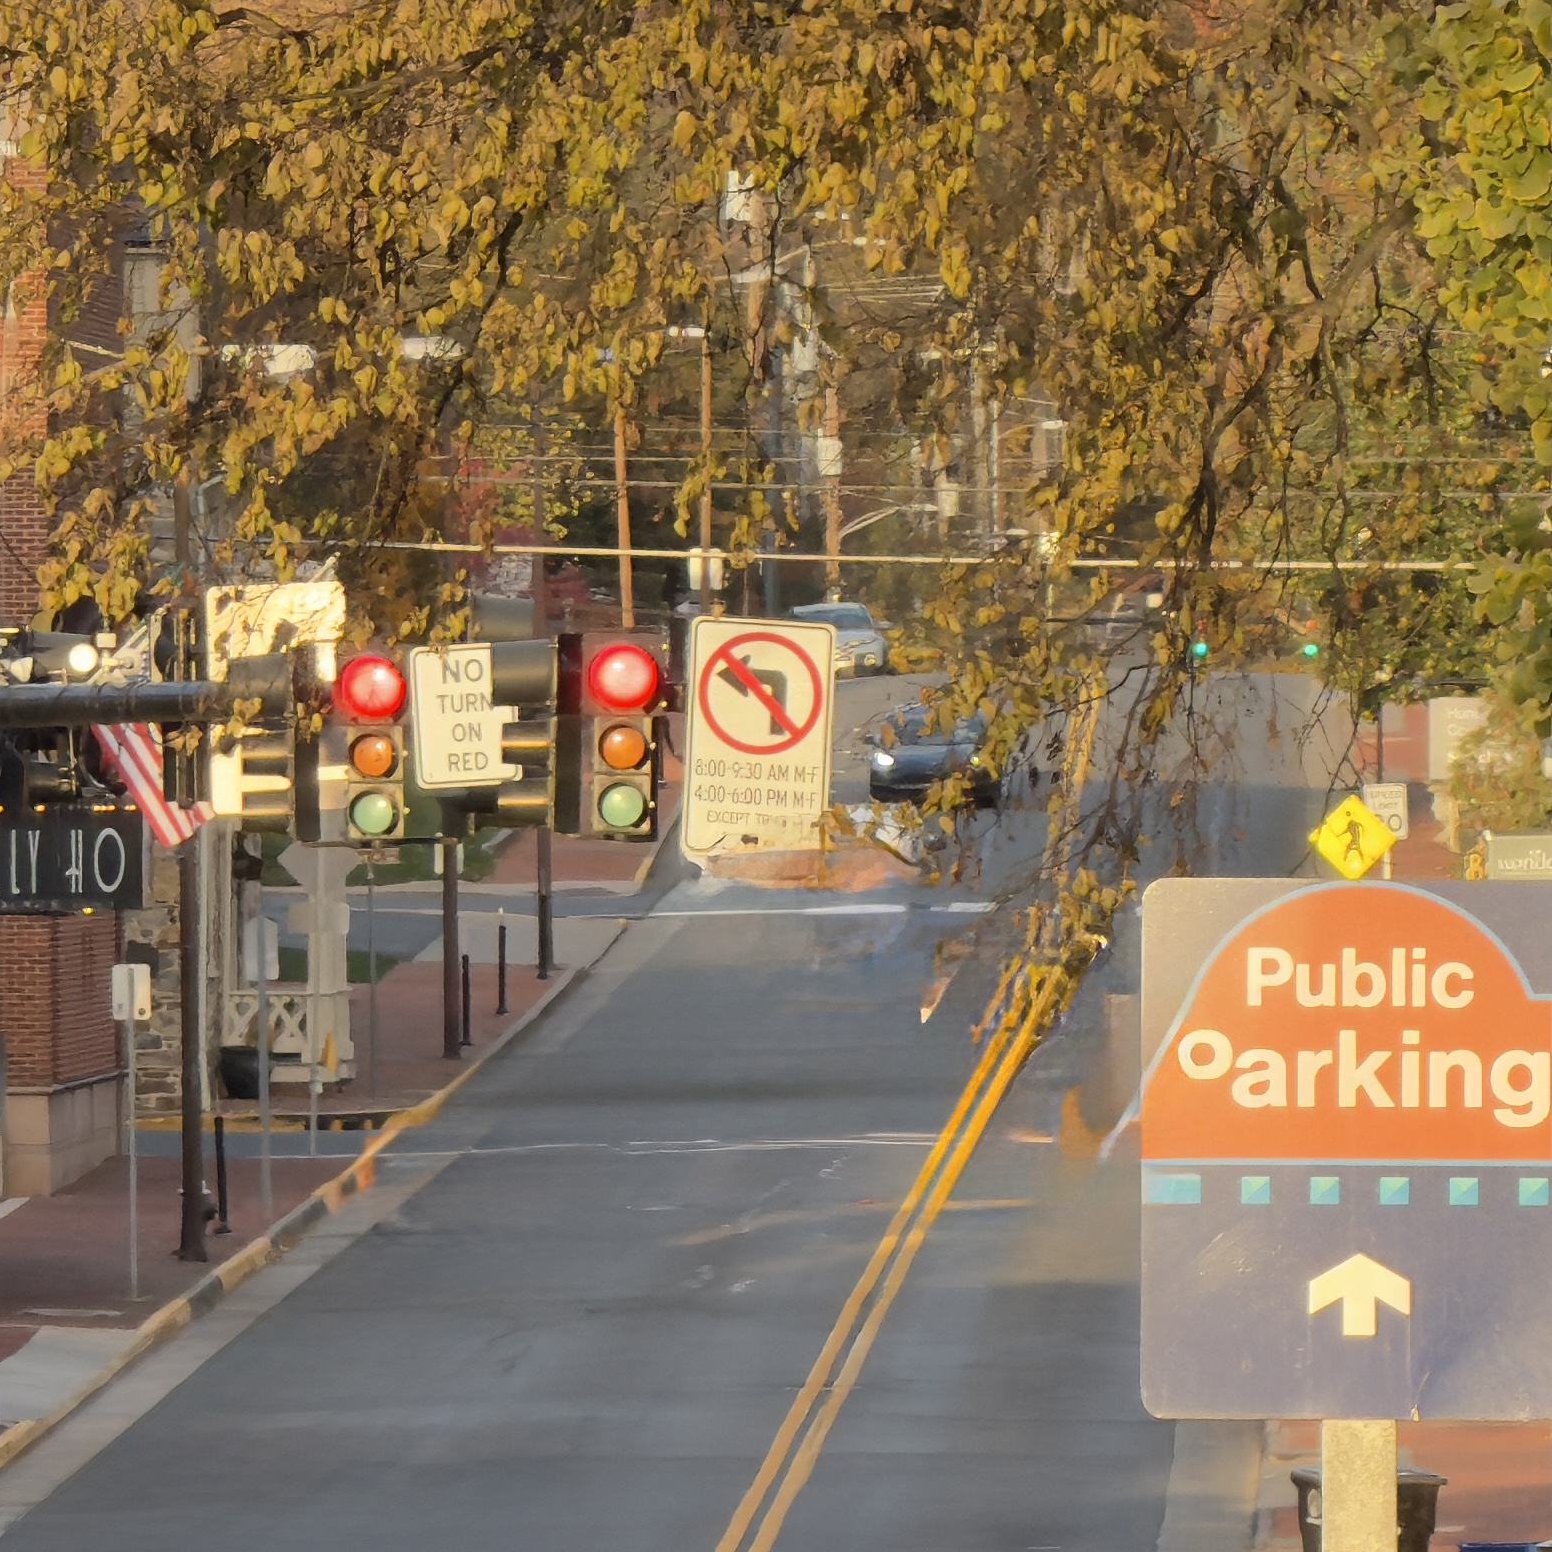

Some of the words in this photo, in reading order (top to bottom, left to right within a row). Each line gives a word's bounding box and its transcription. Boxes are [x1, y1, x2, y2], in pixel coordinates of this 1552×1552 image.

[441, 658, 484, 685] NO
[436, 692, 493, 715] TURN
[452, 722, 483, 742] ON
[447, 751, 489, 772] RED
[767, 763, 789, 782] AM
[793, 765, 820, 784] M-F
[694, 784, 762, 806] 4:00-6:00
[766, 788, 788, 807] PM
[792, 791, 818, 809] M-F
[65, 827, 126, 893] HO
[1247, 947, 1475, 1009] Public
